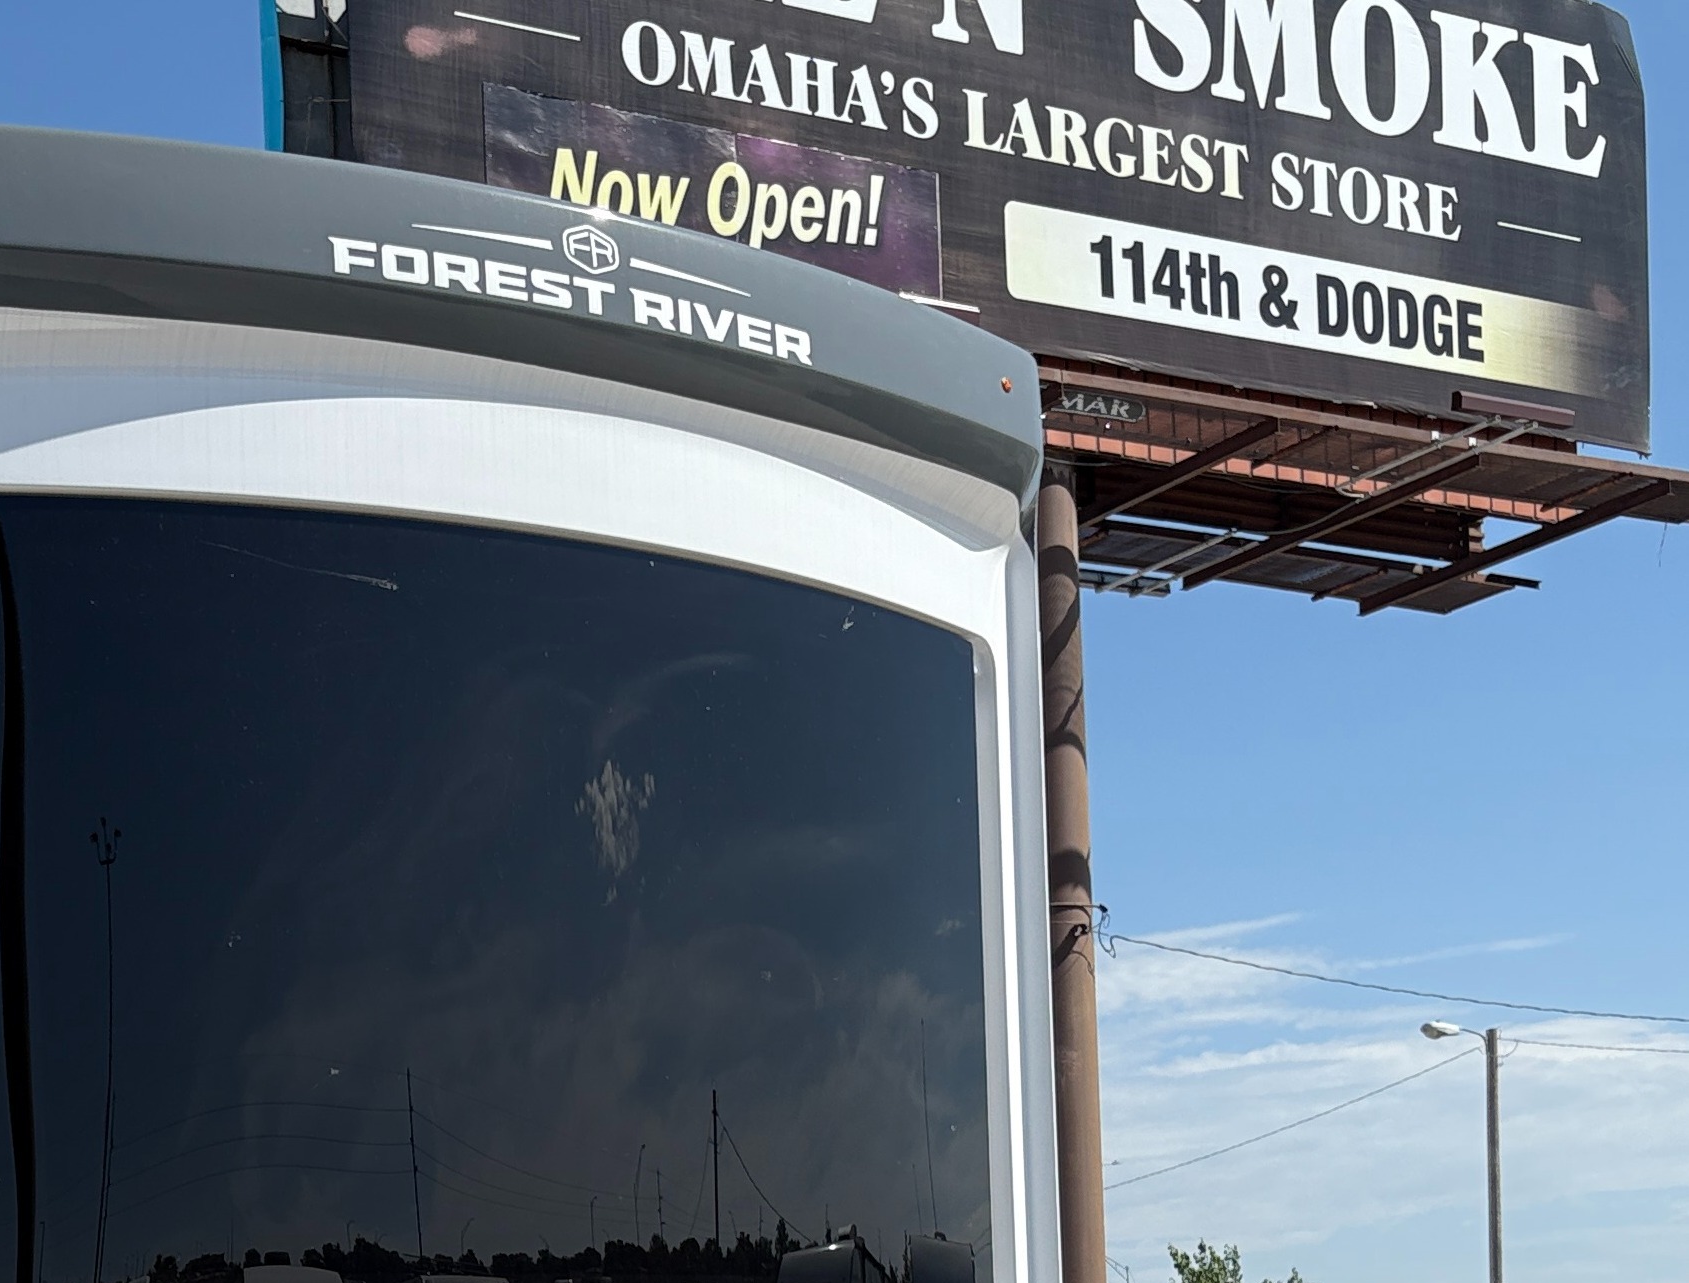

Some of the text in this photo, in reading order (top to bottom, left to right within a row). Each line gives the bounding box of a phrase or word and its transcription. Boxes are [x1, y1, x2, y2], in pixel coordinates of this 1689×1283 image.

[621, 20, 1462, 242] OMAHA'S LARGEST STORE
[1133, 0, 1607, 179] SMOKE
[550, 147, 885, 249] Now Open!
[327, 235, 813, 365] FOREST RIVER
[1090, 234, 1485, 363] 114th & DODGE
